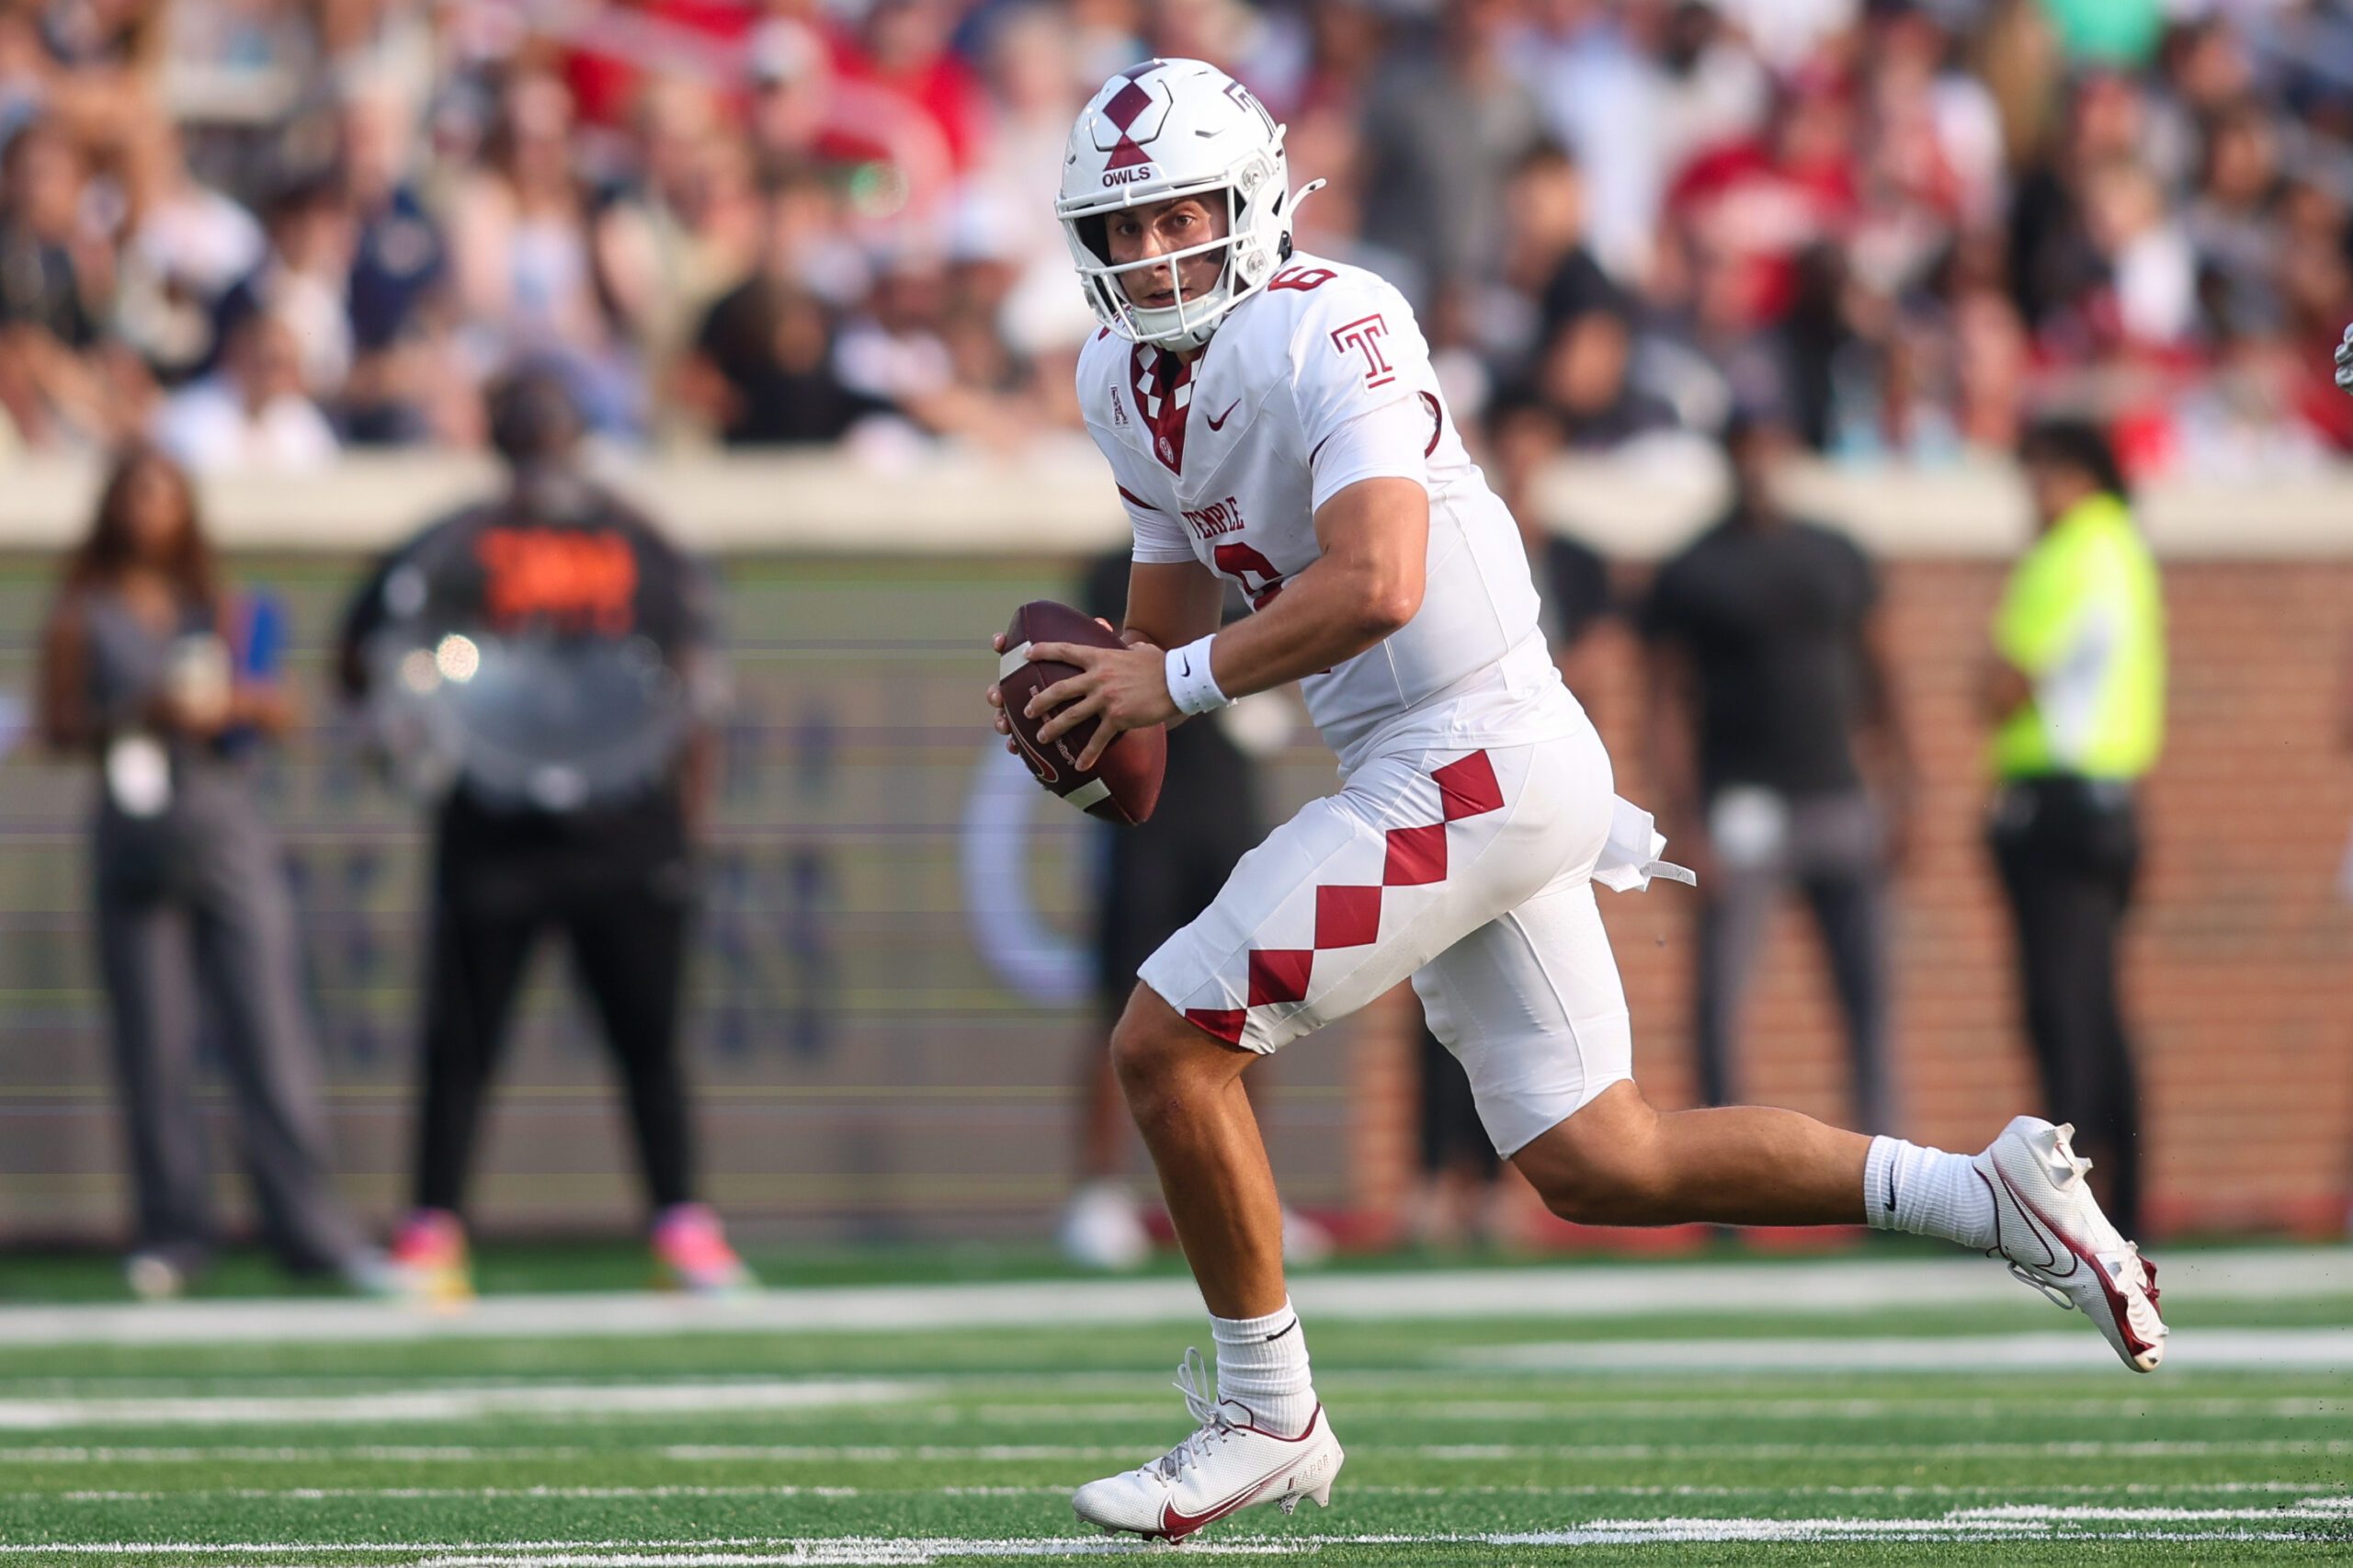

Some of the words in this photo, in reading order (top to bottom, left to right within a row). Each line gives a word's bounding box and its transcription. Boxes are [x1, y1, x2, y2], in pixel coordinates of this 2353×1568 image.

[1102, 166, 1151, 187] OWLS
[1267, 266, 1338, 291] 6
[1330, 313, 1396, 389] T
[1180, 496, 1245, 540] TEMPLE
